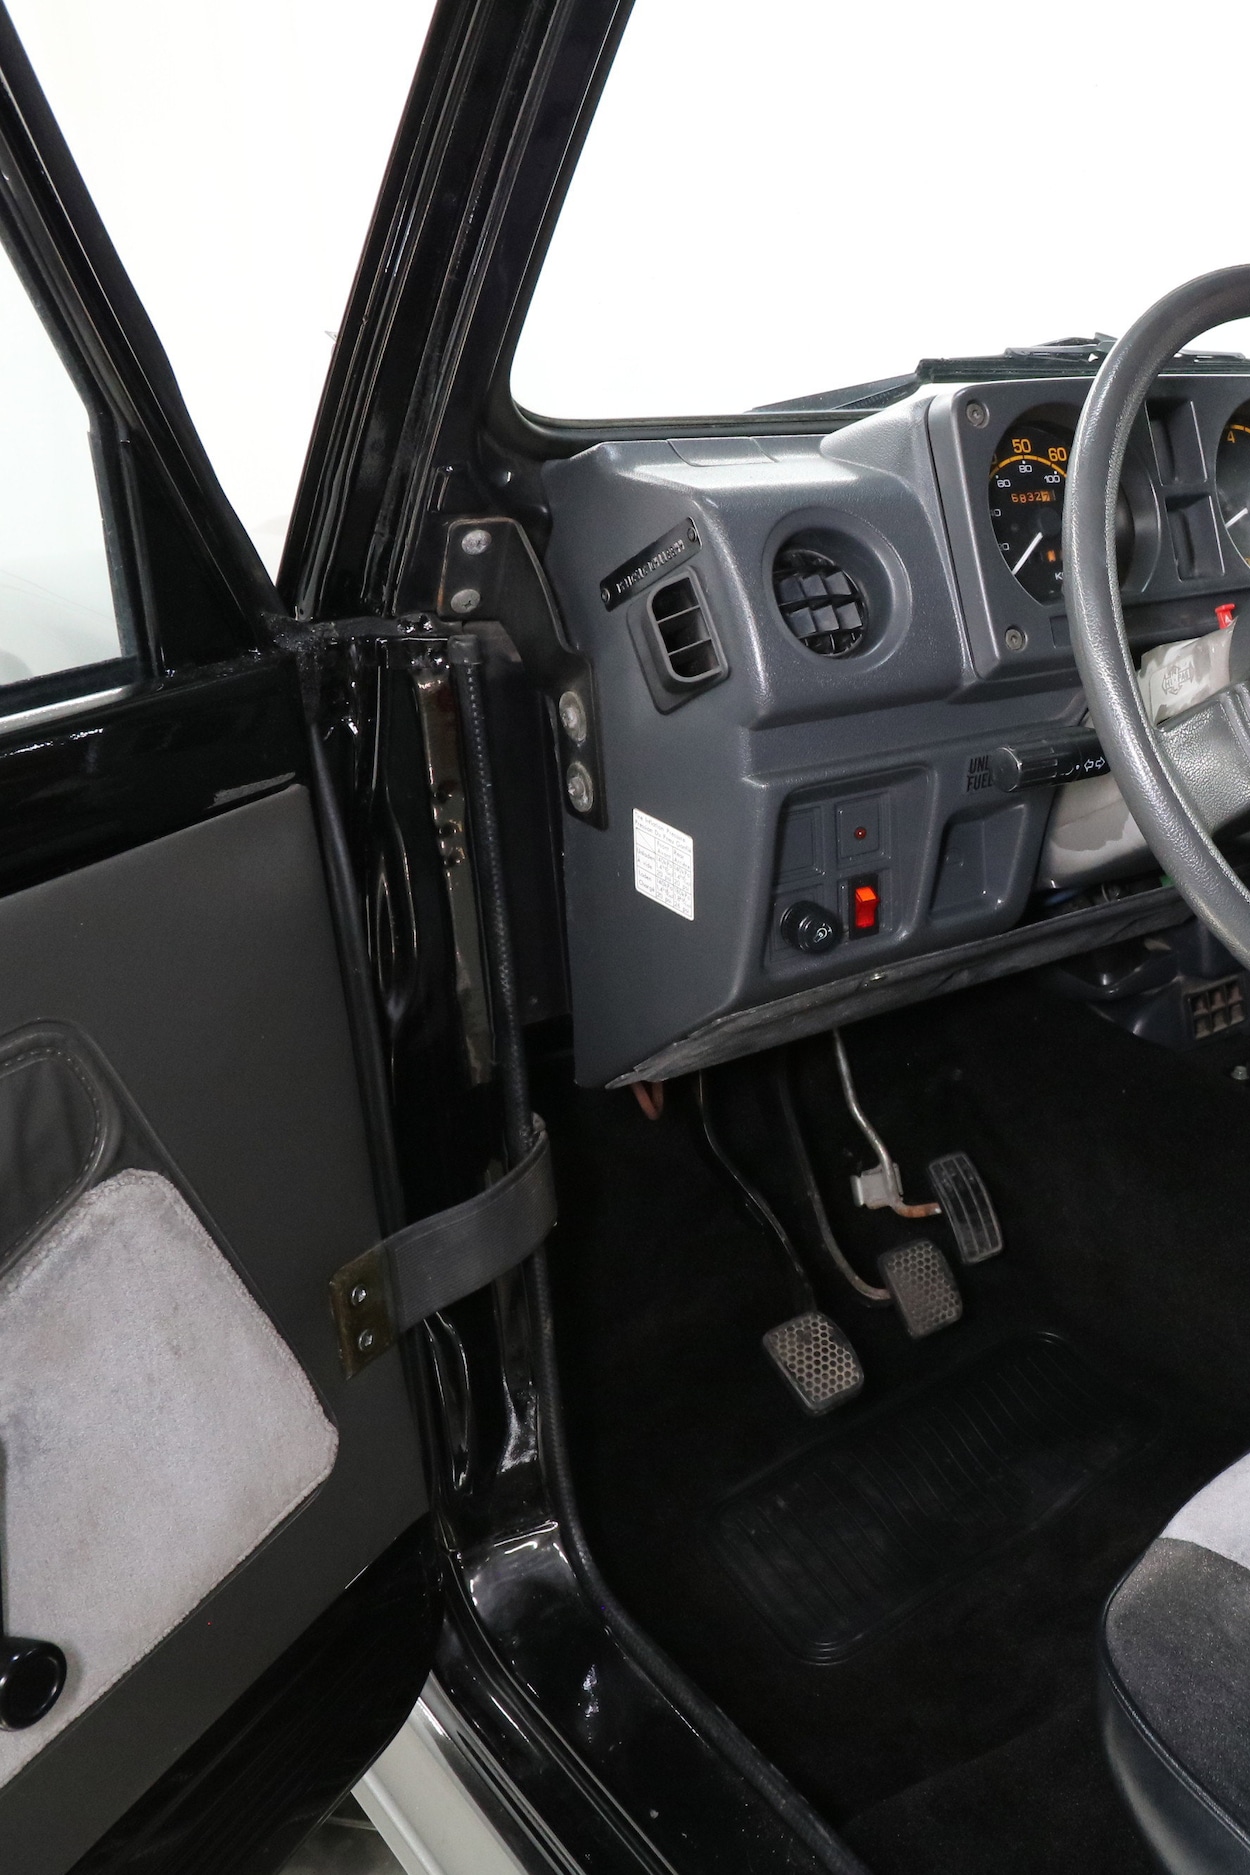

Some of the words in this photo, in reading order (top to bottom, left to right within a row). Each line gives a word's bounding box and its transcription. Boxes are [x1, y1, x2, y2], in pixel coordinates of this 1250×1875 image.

[1227, 430, 1236, 443] 4
[1012, 438, 1032, 453] 50
[1047, 446, 1067, 461] 60
[1018, 464, 1032, 473] 80
[996, 479, 1011, 488] 60
[1043, 474, 1060, 483] 100
[966, 772, 993, 792] FUEL
